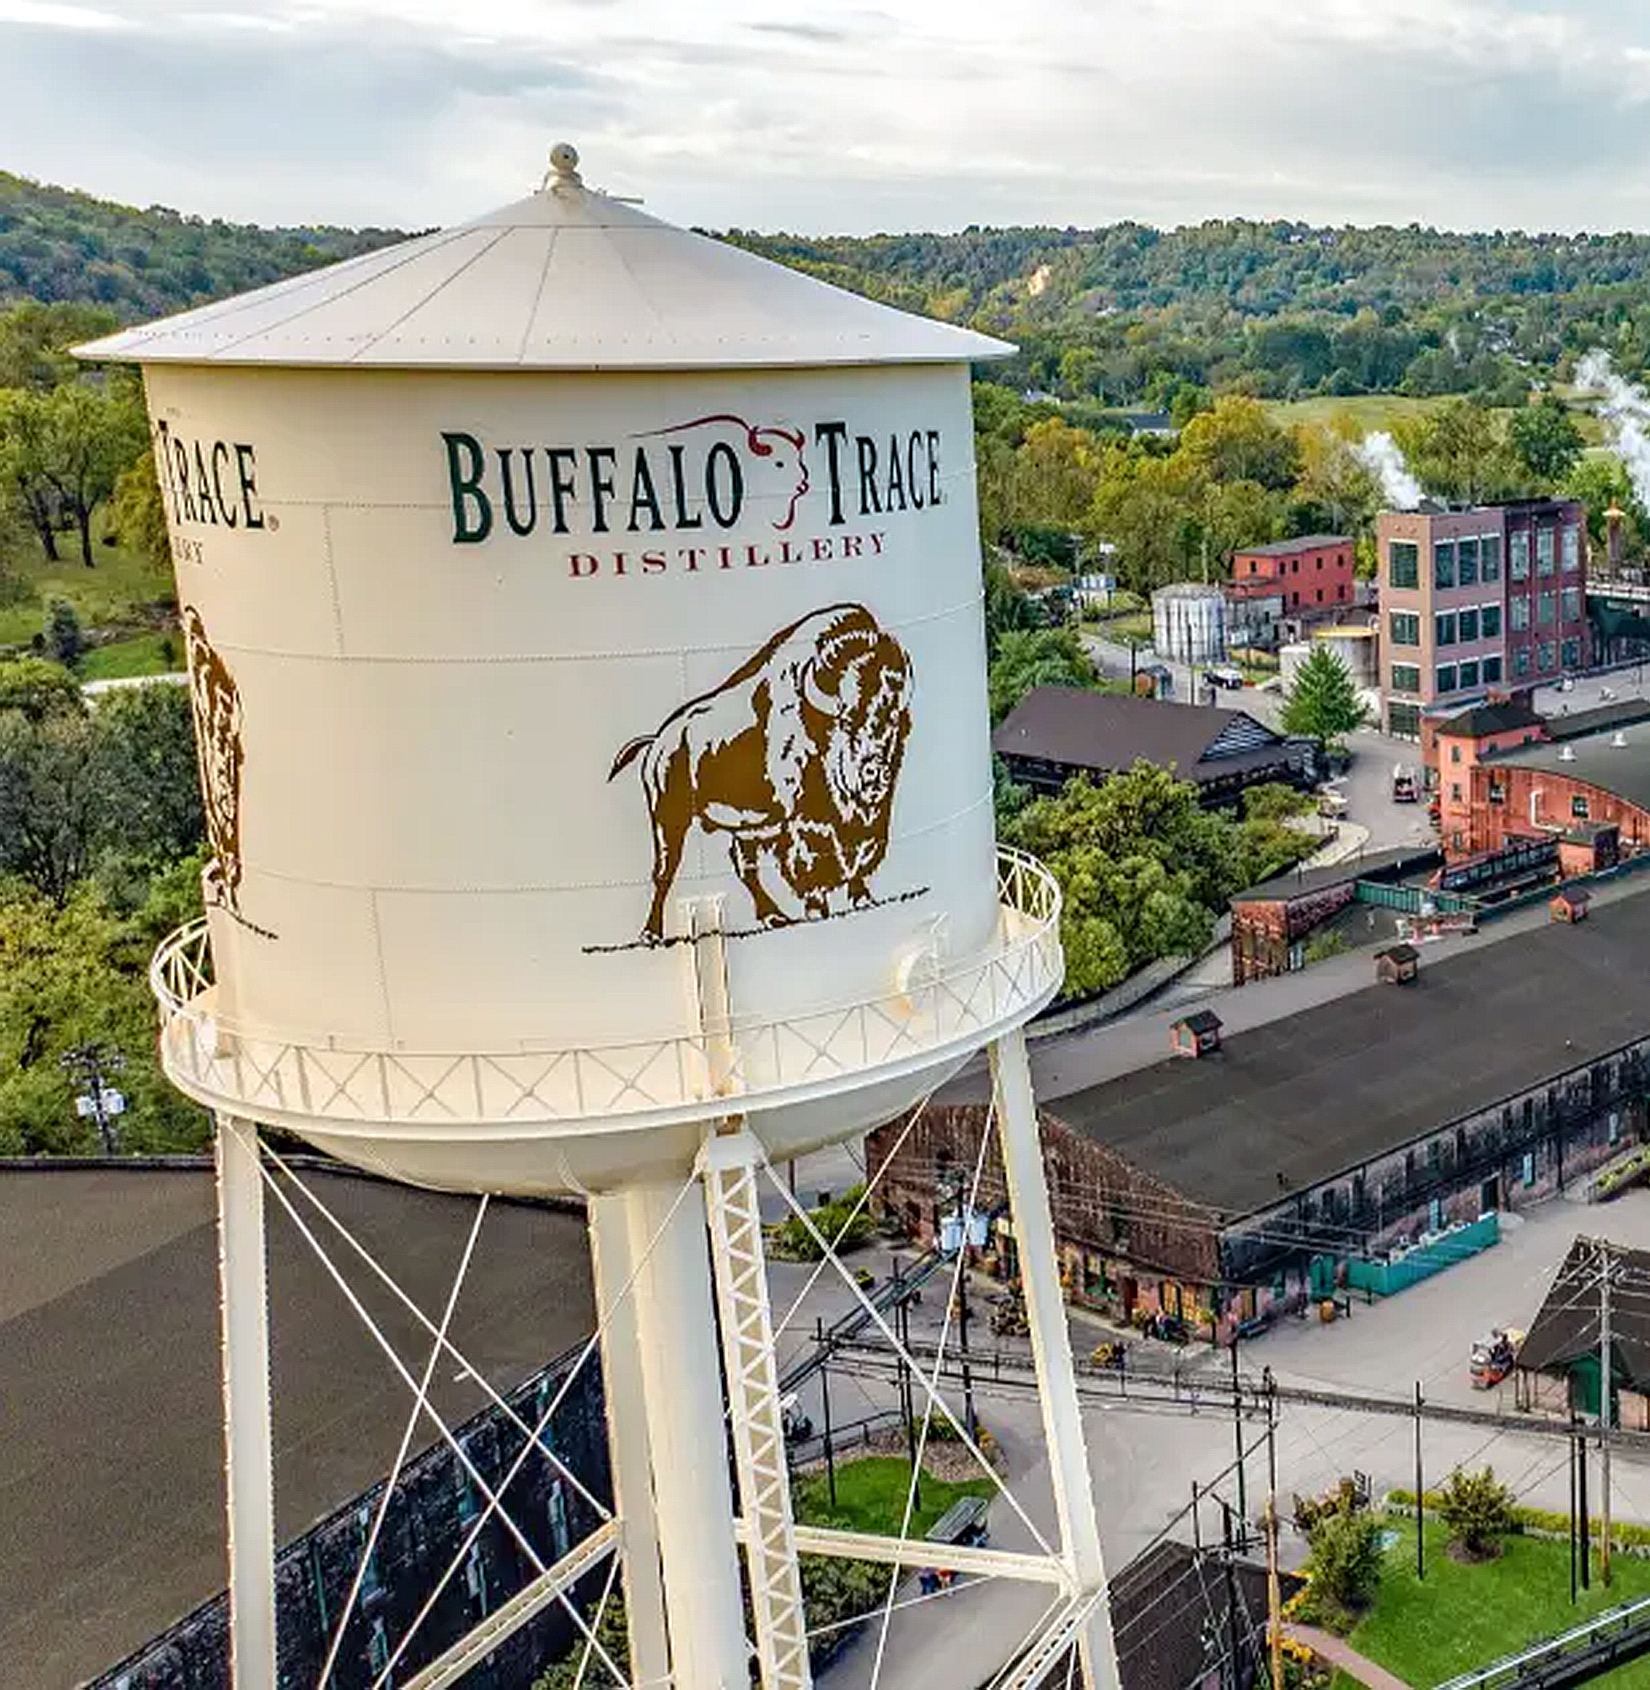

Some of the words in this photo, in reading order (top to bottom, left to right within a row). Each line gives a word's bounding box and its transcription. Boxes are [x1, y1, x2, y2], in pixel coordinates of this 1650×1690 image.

[440, 431, 744, 544] BUFFALO
[814, 422, 942, 526] TRACE
[568, 533, 886, 578] DISTILLERY
